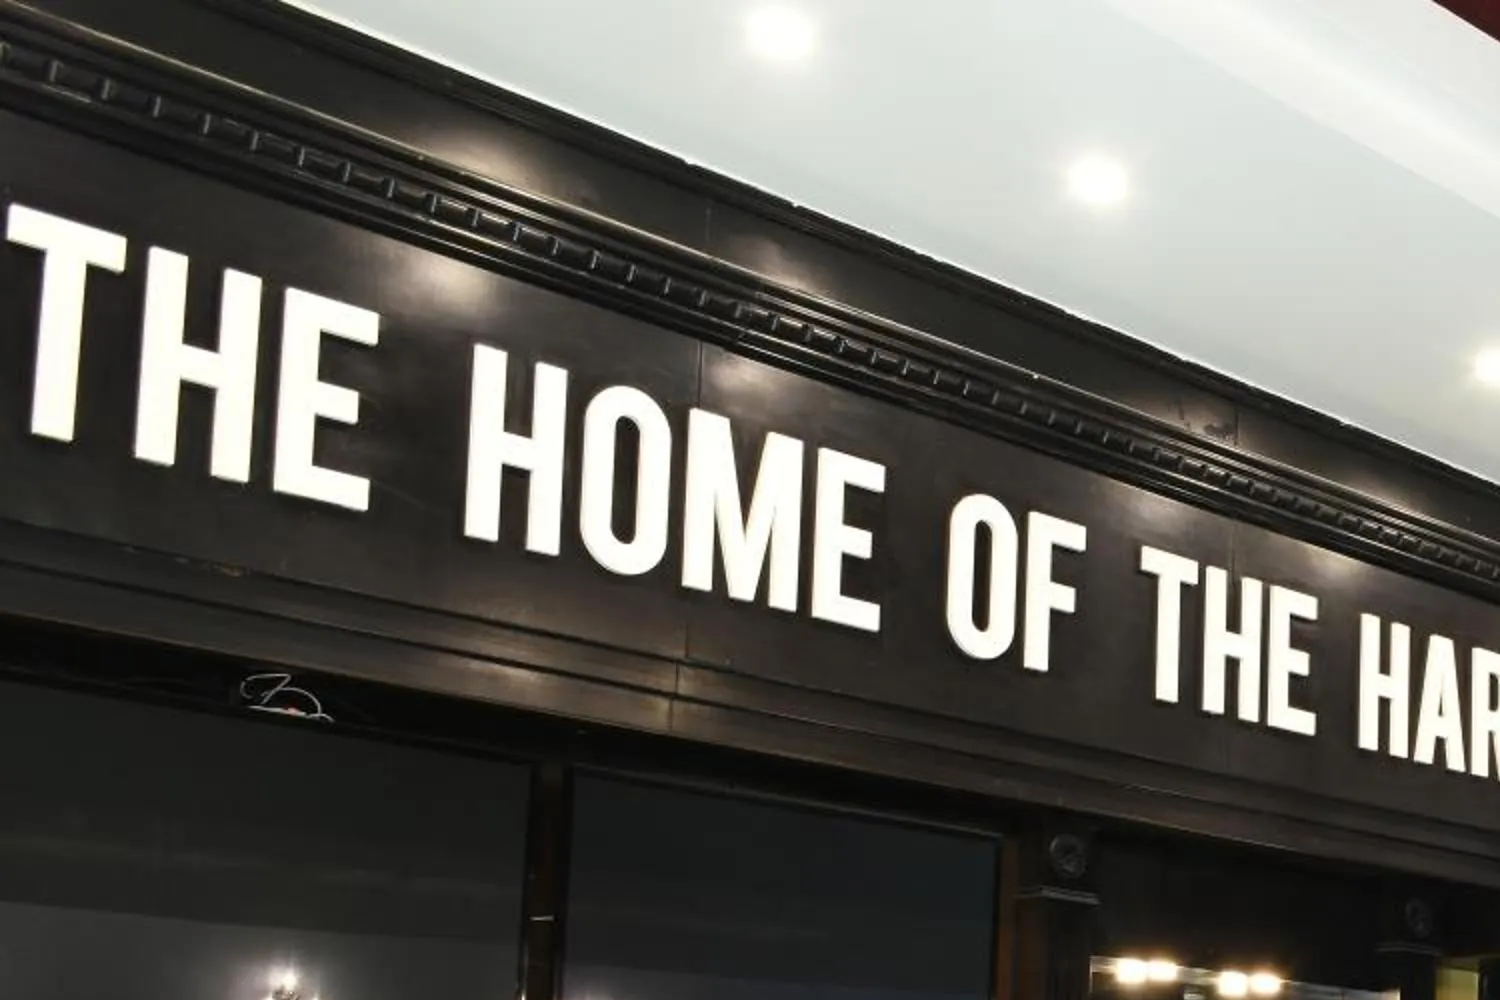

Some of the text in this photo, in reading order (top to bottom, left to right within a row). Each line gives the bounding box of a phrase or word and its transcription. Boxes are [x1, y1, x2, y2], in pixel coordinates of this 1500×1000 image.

[7, 203, 382, 513] THE
[463, 343, 888, 634] HOME
[945, 493, 1088, 673] OF
[1140, 545, 1319, 737] THE
